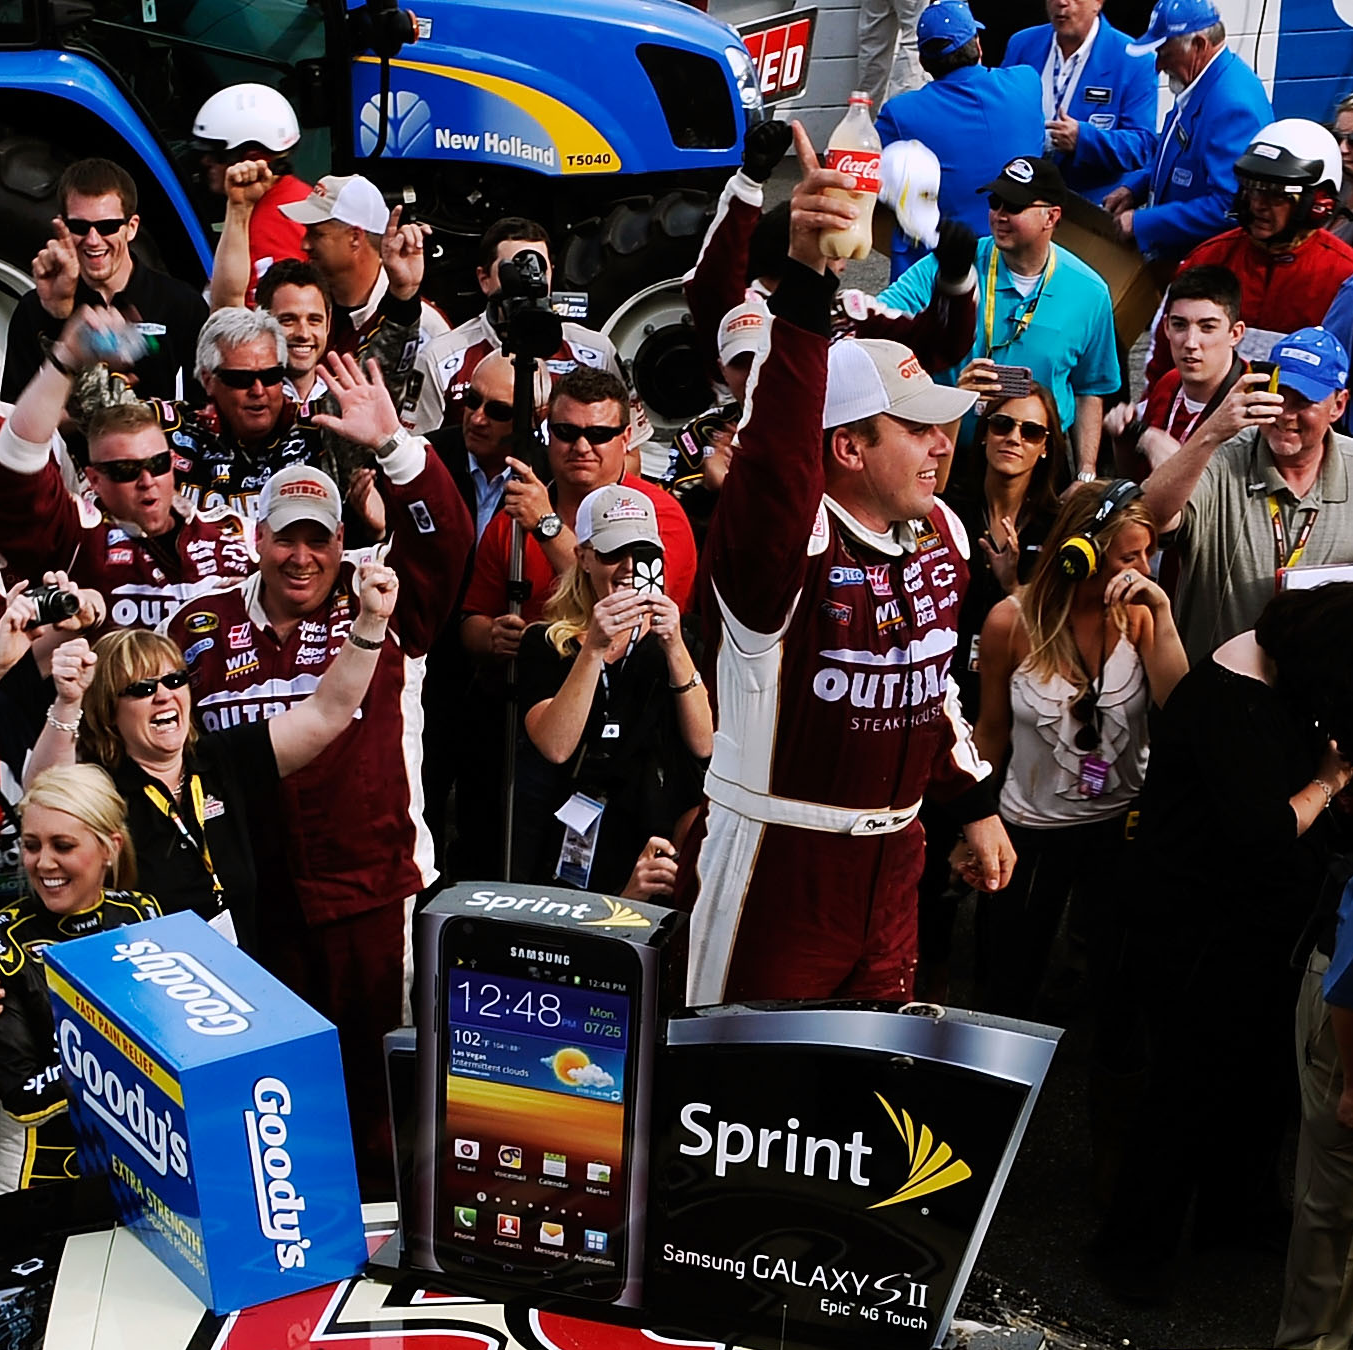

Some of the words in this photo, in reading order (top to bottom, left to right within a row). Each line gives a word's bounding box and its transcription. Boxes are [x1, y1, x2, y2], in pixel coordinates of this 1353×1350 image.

[435, 128, 480, 152] New
[484, 132, 555, 167] Holland
[566, 153, 612, 167] T5040
[279, 485, 329, 499] OUTBACK
[226, 649, 259, 672] WIX
[464, 889, 593, 921] Sprint
[510, 946, 571, 965] SAMSUNG
[111, 938, 254, 1036] Goody's
[457, 980, 562, 1027] 12:48
[584, 1021, 622, 1039] 07/25
[589, 1005, 618, 1020] Mon.
[75, 995, 97, 1026] FAST
[98, 1016, 121, 1047] PAIN
[121, 1037, 154, 1077] RELIEF
[452, 1048, 465, 1057] Las
[466, 1050, 487, 1061] Vegas
[452, 1057, 501, 1074] Intermittent
[502, 1065, 529, 1078] clouds
[58, 1018, 189, 1180] Goody's
[678, 1102, 876, 1188] Sprint
[247, 1077, 311, 1273] Goody's
[457, 1162, 477, 1173] Email
[494, 1169, 527, 1182] Voicemail
[538, 1177, 570, 1189] Calendar
[585, 1185, 611, 1197] Market
[111, 1153, 145, 1199] EXTRA
[145, 1187, 202, 1257] STRENGTH
[454, 1231, 476, 1242] Phone
[493, 1238, 523, 1251] Contacts
[534, 1245, 570, 1261] Messaging
[573, 1252, 616, 1268] Applications
[662, 1243, 746, 1280] Samsung
[752, 1253, 869, 1299] GALAXY
[859, 1305, 881, 1322] 4G
[886, 1308, 928, 1331] Touch
